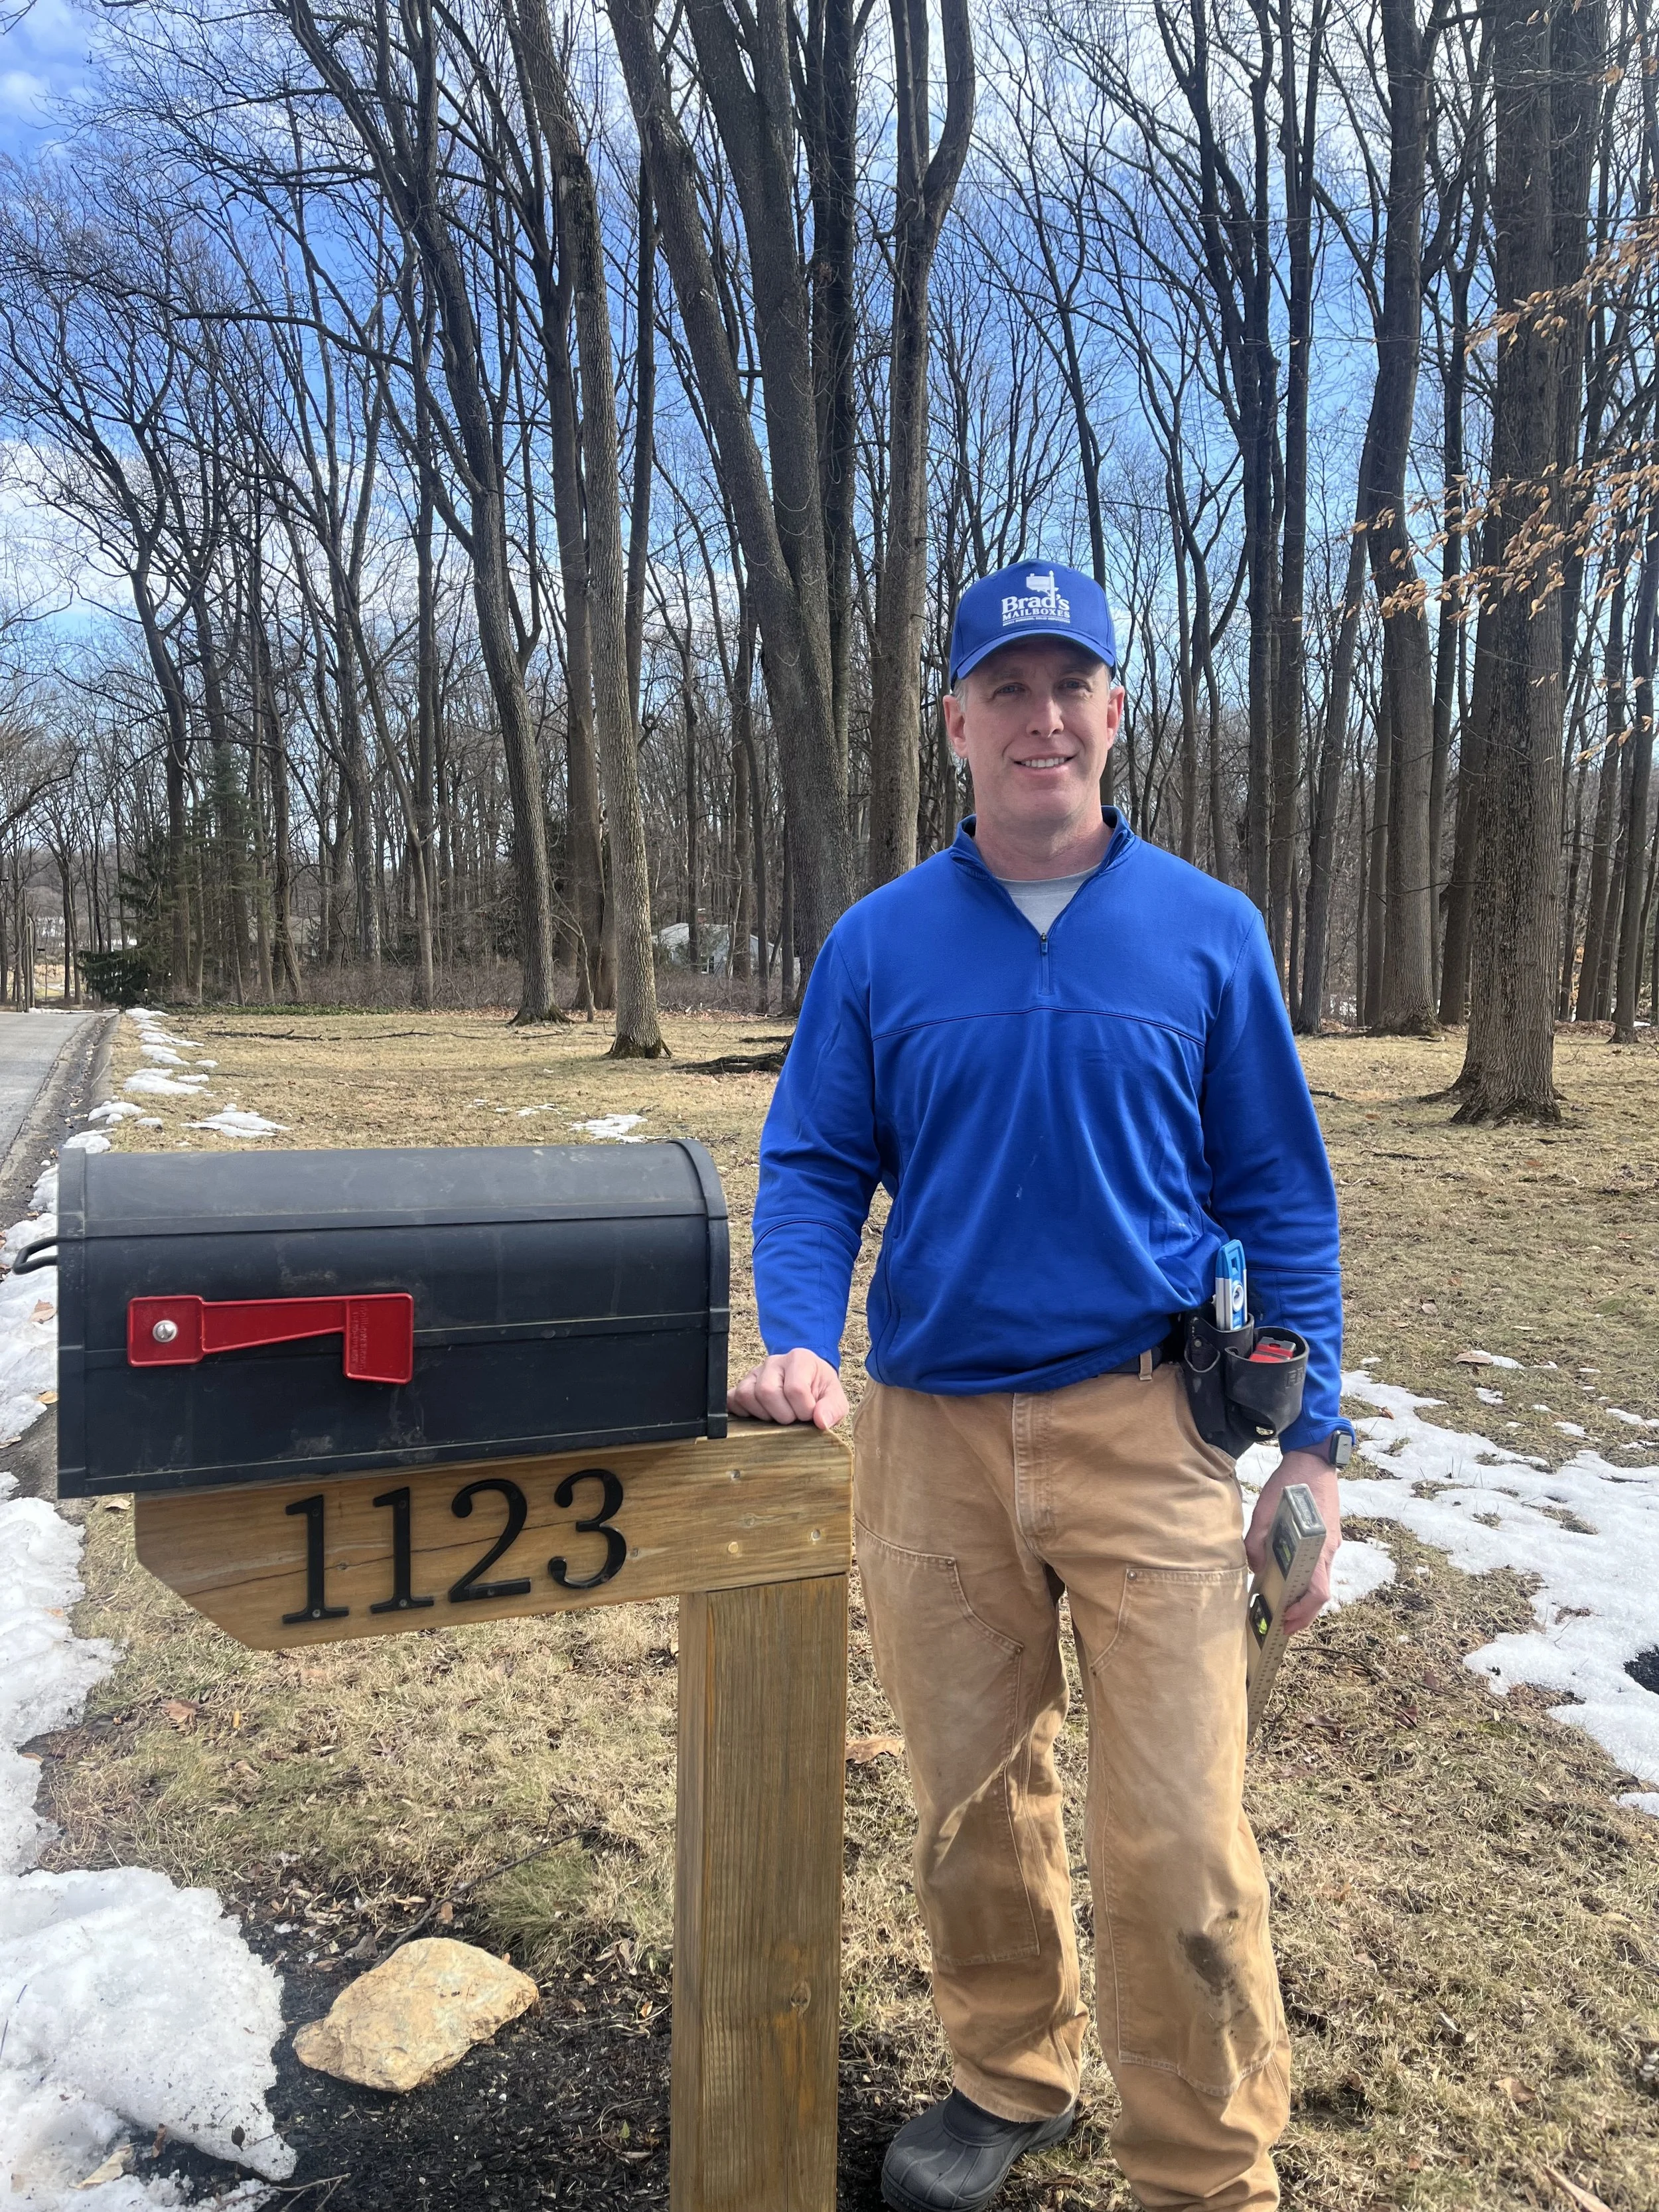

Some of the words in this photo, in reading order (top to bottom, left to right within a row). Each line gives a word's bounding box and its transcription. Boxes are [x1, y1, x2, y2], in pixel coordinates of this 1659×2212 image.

[1001, 593, 1070, 615] Brad's
[1002, 607, 1070, 622] MAILBOXES
[283, 1468, 627, 1624] 1123
